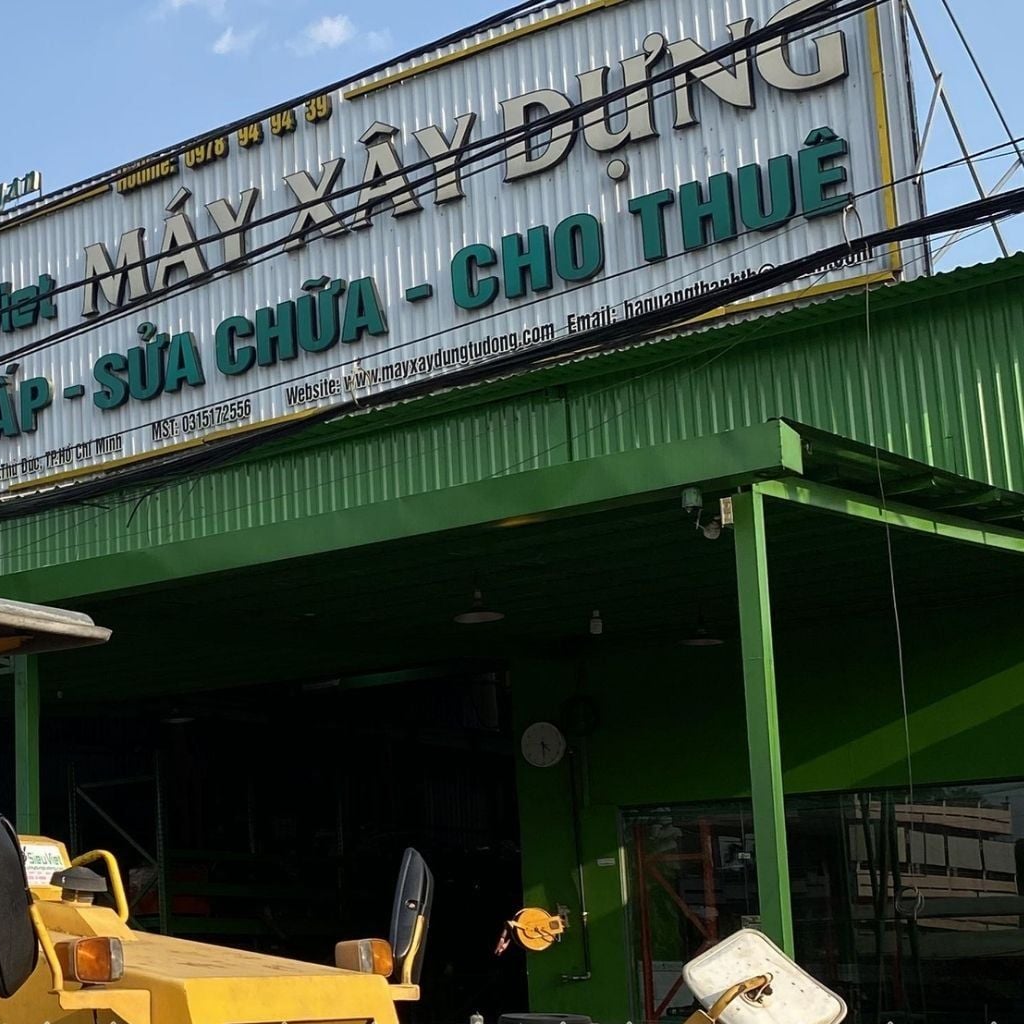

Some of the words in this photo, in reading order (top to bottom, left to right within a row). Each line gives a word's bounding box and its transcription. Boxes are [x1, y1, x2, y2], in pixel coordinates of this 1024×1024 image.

[80, 187, 260, 319] MÁY
[282, 112, 477, 254] XÂY
[499, 0, 850, 184] DỰNG
[63, 384, 85, 401] -
[92, 322, 206, 411] SỬA
[214, 275, 389, 376] CHỮA
[405, 281, 433, 302] -
[450, 212, 605, 310] CHO
[627, 126, 850, 263] THUÊ
[567, 304, 618, 335] Email:
[285, 378, 342, 407] Website:
[342, 321, 556, 393] www.mayxaydungtudong.com
[152, 415, 180, 442] MST:
[181, 399, 252, 434] 0315172556
